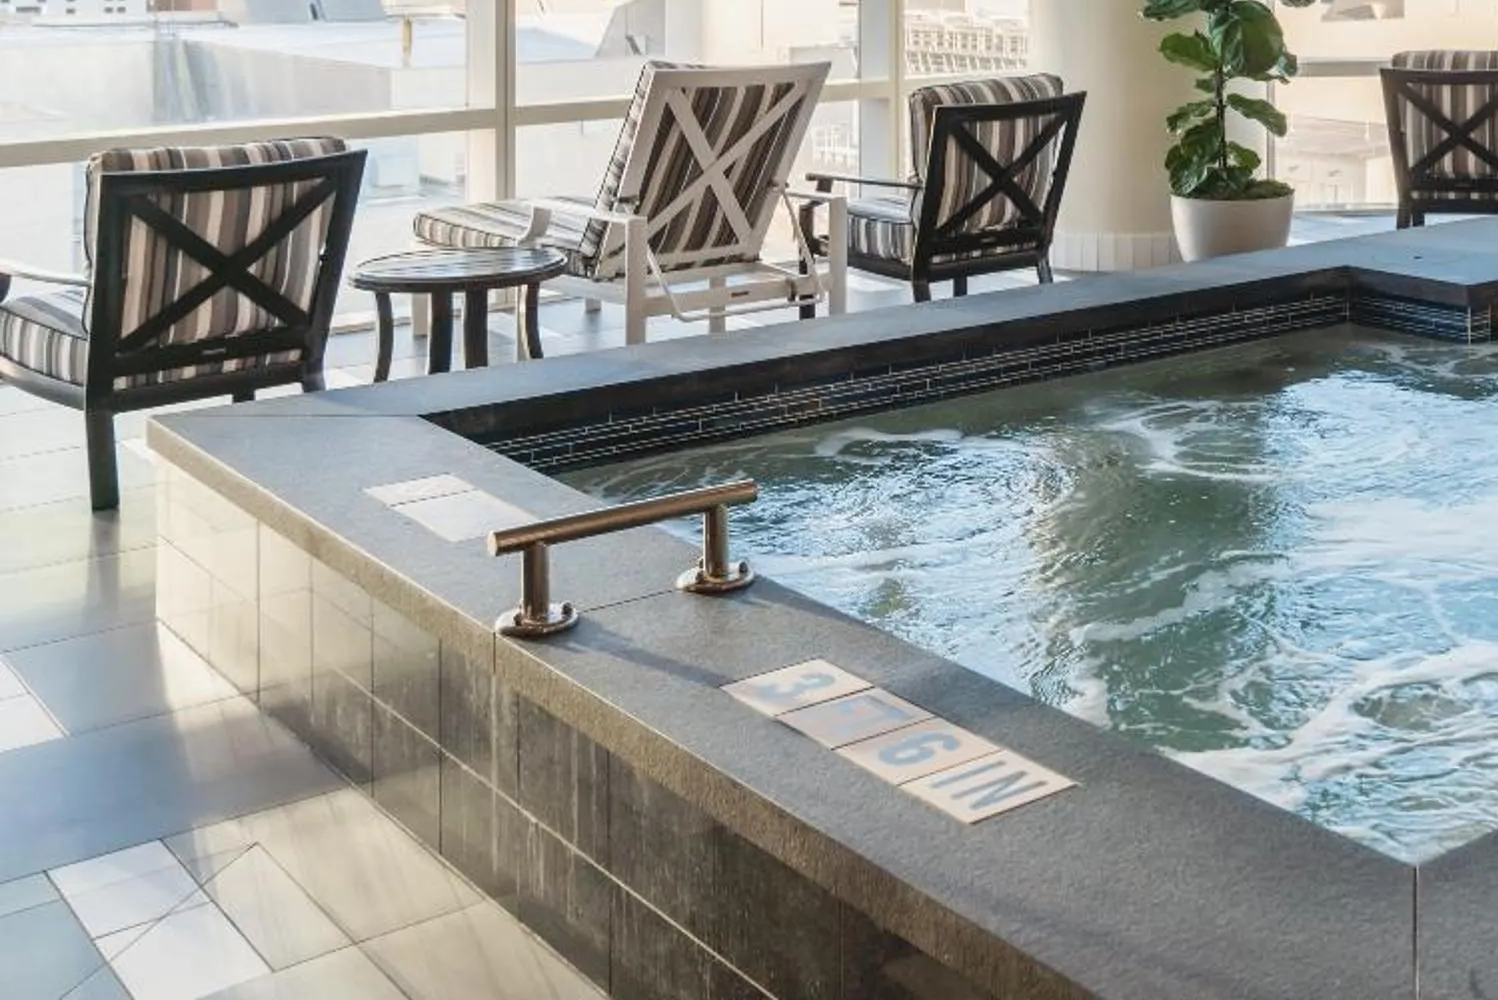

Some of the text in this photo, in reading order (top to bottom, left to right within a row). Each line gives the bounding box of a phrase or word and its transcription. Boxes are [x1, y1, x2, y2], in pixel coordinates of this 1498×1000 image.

[752, 672, 836, 701] 3
[878, 730, 961, 766] 6
[929, 760, 1048, 811] IN
